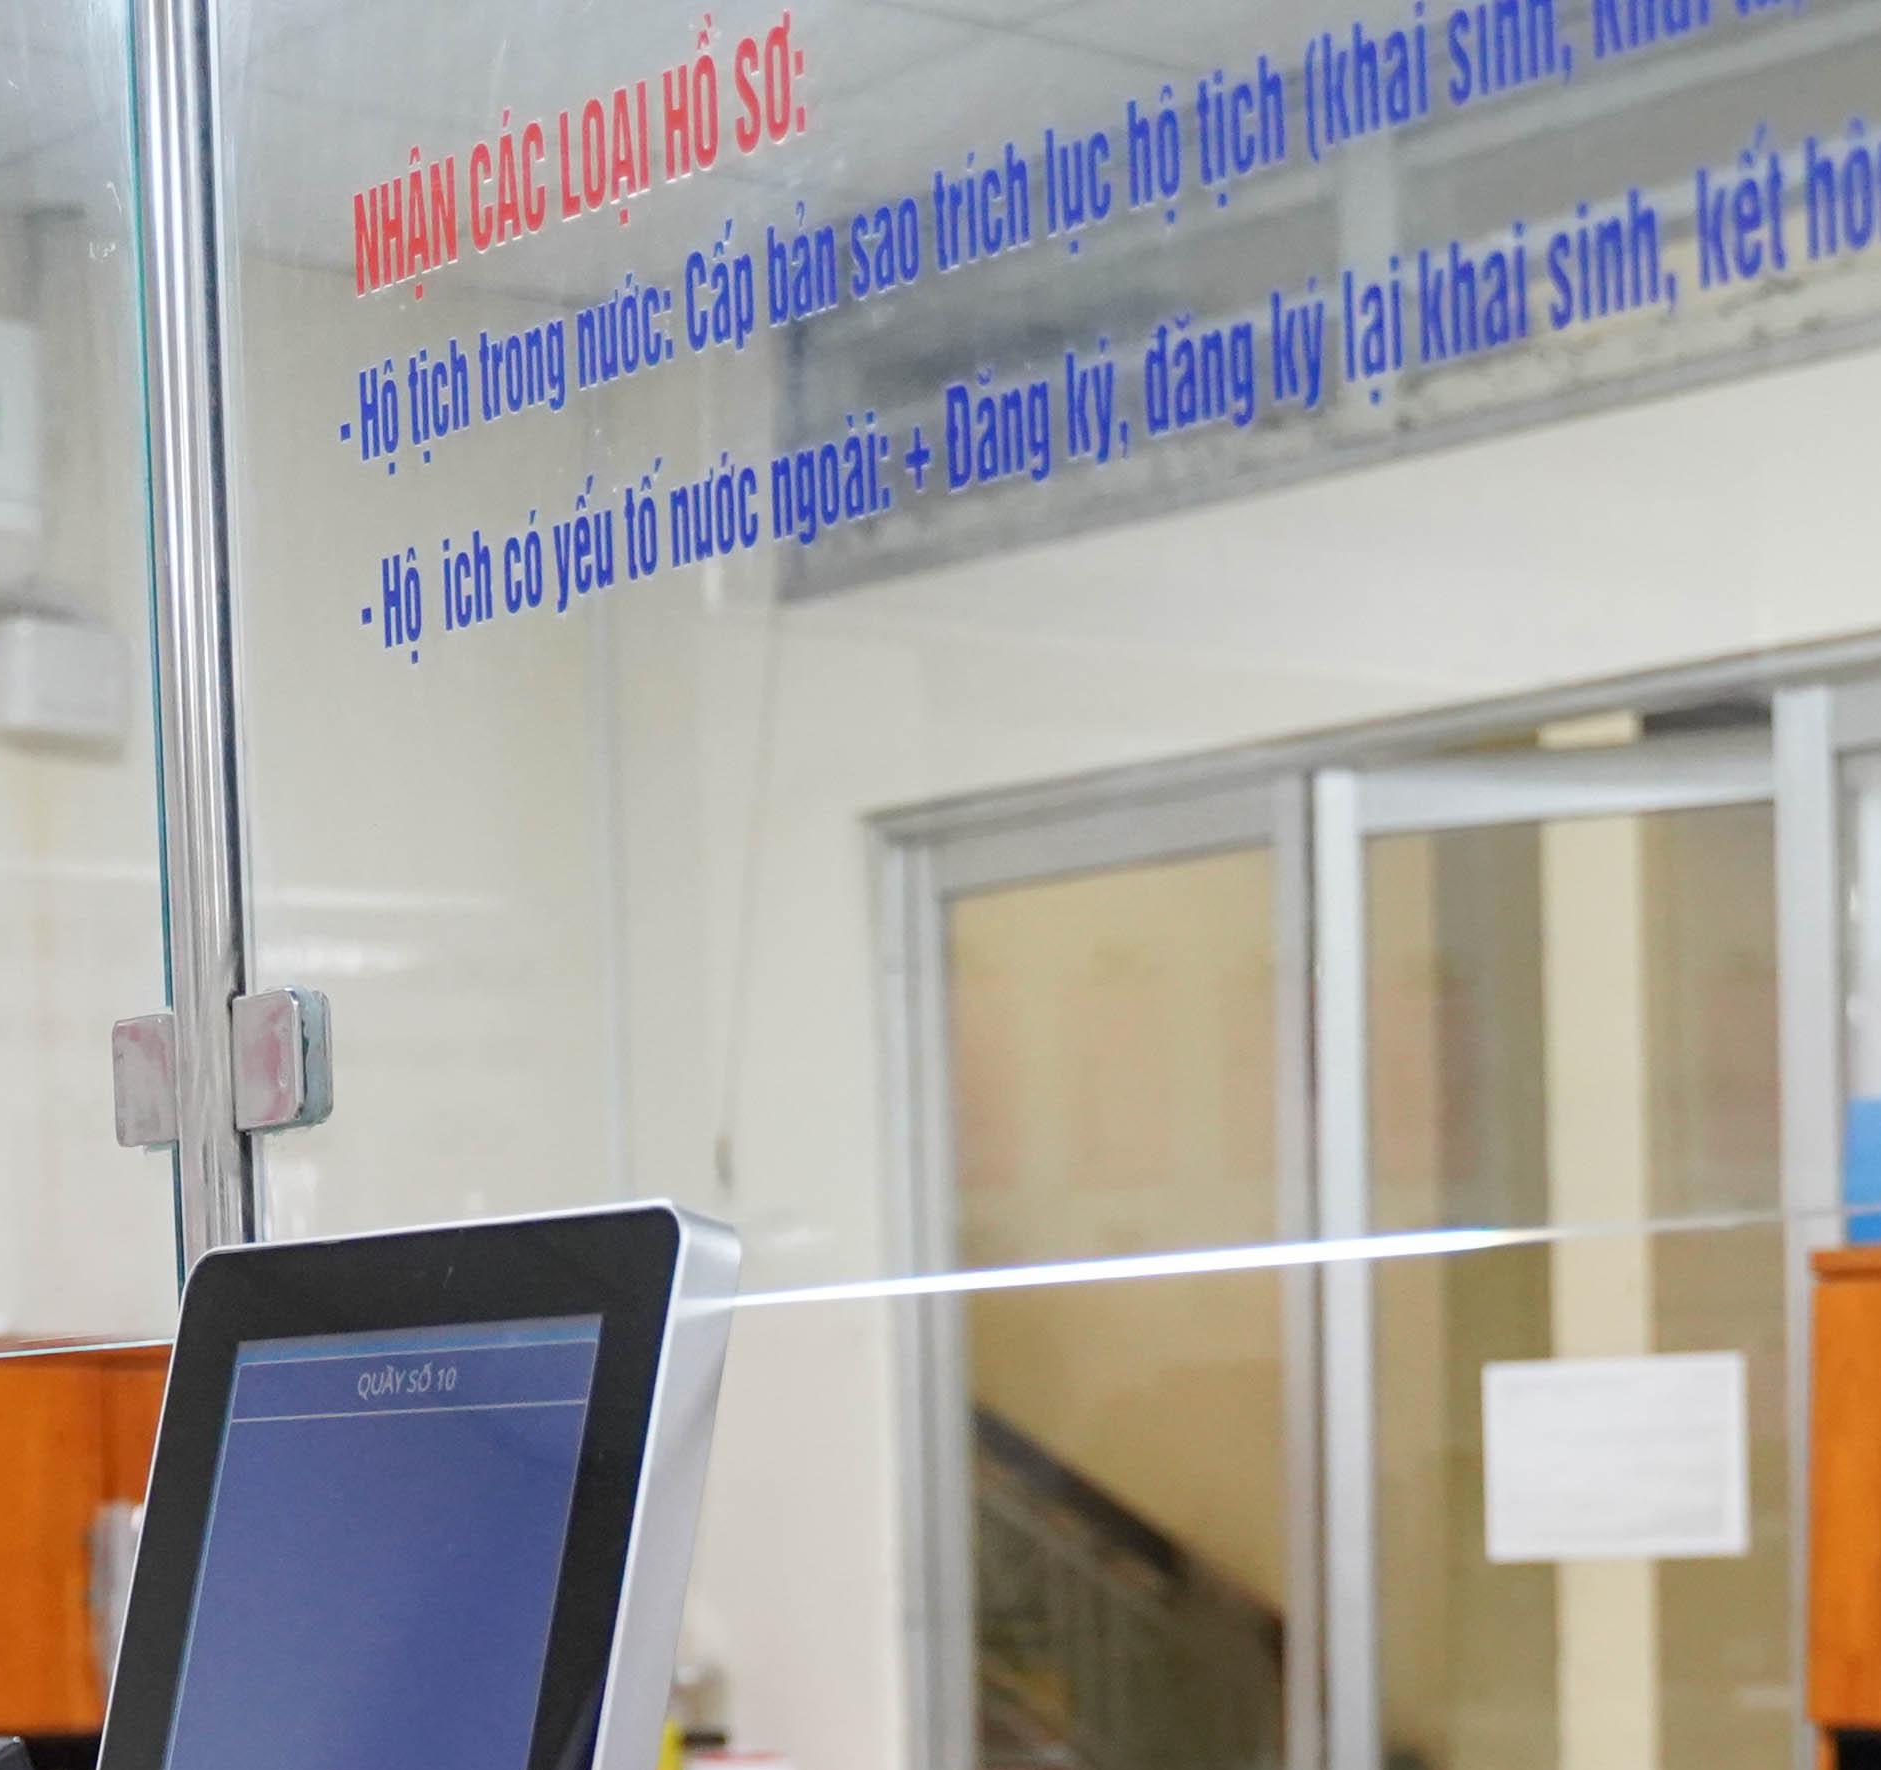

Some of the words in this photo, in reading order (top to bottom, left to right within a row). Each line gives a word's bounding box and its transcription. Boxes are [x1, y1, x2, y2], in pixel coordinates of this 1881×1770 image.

[354, 145, 458, 300] NHẬN
[470, 109, 545, 254] CÁC
[559, 81, 650, 225] LOẠI
[662, 13, 718, 183] HỒ
[735, 10, 805, 154] SƠ:
[359, 359, 398, 474] Hộ
[408, 339, 469, 464] tịch
[479, 320, 566, 412] trong
[577, 273, 673, 390] nước:
[685, 219, 755, 352] Cấp
[767, 201, 839, 327] bản
[851, 198, 918, 300] sao
[933, 142, 1031, 272] trích
[1045, 129, 1111, 254] lục
[1127, 85, 1180, 223] hộ
[1197, 54, 1285, 207] tịch
[1305, 1, 1428, 162] (khai
[382, 547, 421, 664] Hộ
[504, 510, 542, 613] có
[554, 474, 613, 613] yếu
[624, 457, 662, 580] tố
[669, 452, 758, 568] nước
[771, 411, 890, 545] ngoài:
[945, 368, 1051, 490] Đăng
[1065, 337, 1128, 465] ký,
[1145, 312, 1255, 435] đăng
[1270, 277, 1323, 409] ký
[1343, 255, 1402, 404] lại
[1419, 220, 1527, 363] khai
[1549, 188, 1678, 331] sinh,
[1696, 122, 1786, 289] kết
[358, 1363, 406, 1400] QUẦY
[407, 1360, 433, 1392] SỐ
[438, 1367, 457, 1392] 10
